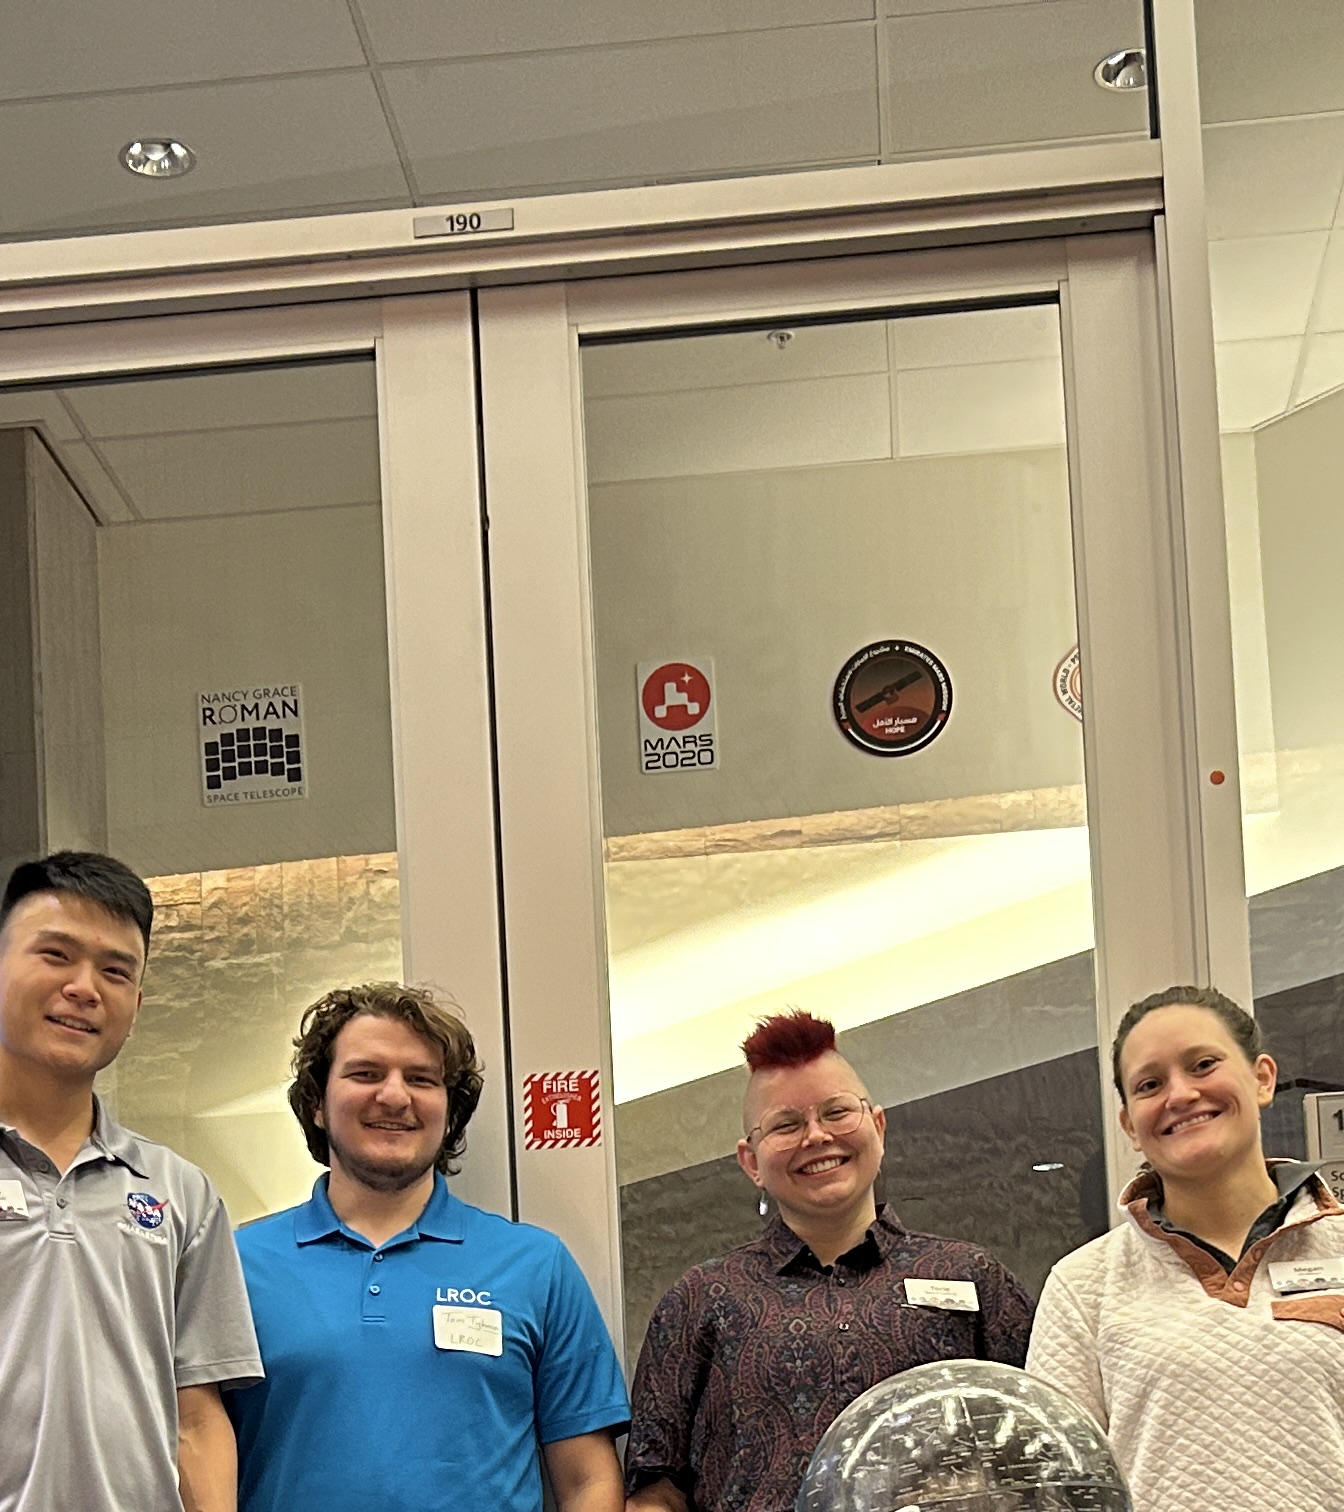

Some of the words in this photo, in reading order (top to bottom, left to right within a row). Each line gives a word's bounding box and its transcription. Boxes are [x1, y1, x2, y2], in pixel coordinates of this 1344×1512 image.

[446, 213, 481, 232] 190
[201, 690, 249, 705] NANCY
[253, 685, 297, 700] GRACE
[202, 700, 299, 726] ROMAN
[644, 734, 713, 752] MARS
[644, 750, 714, 770] 2020
[207, 792, 240, 804] SPACE
[243, 786, 303, 801] TELESCOPE
[542, 1079, 579, 1094] FIRE
[544, 1128, 582, 1140] INSIDE
[436, 1287, 492, 1306] LROC
[450, 1333, 484, 1348] LROC
